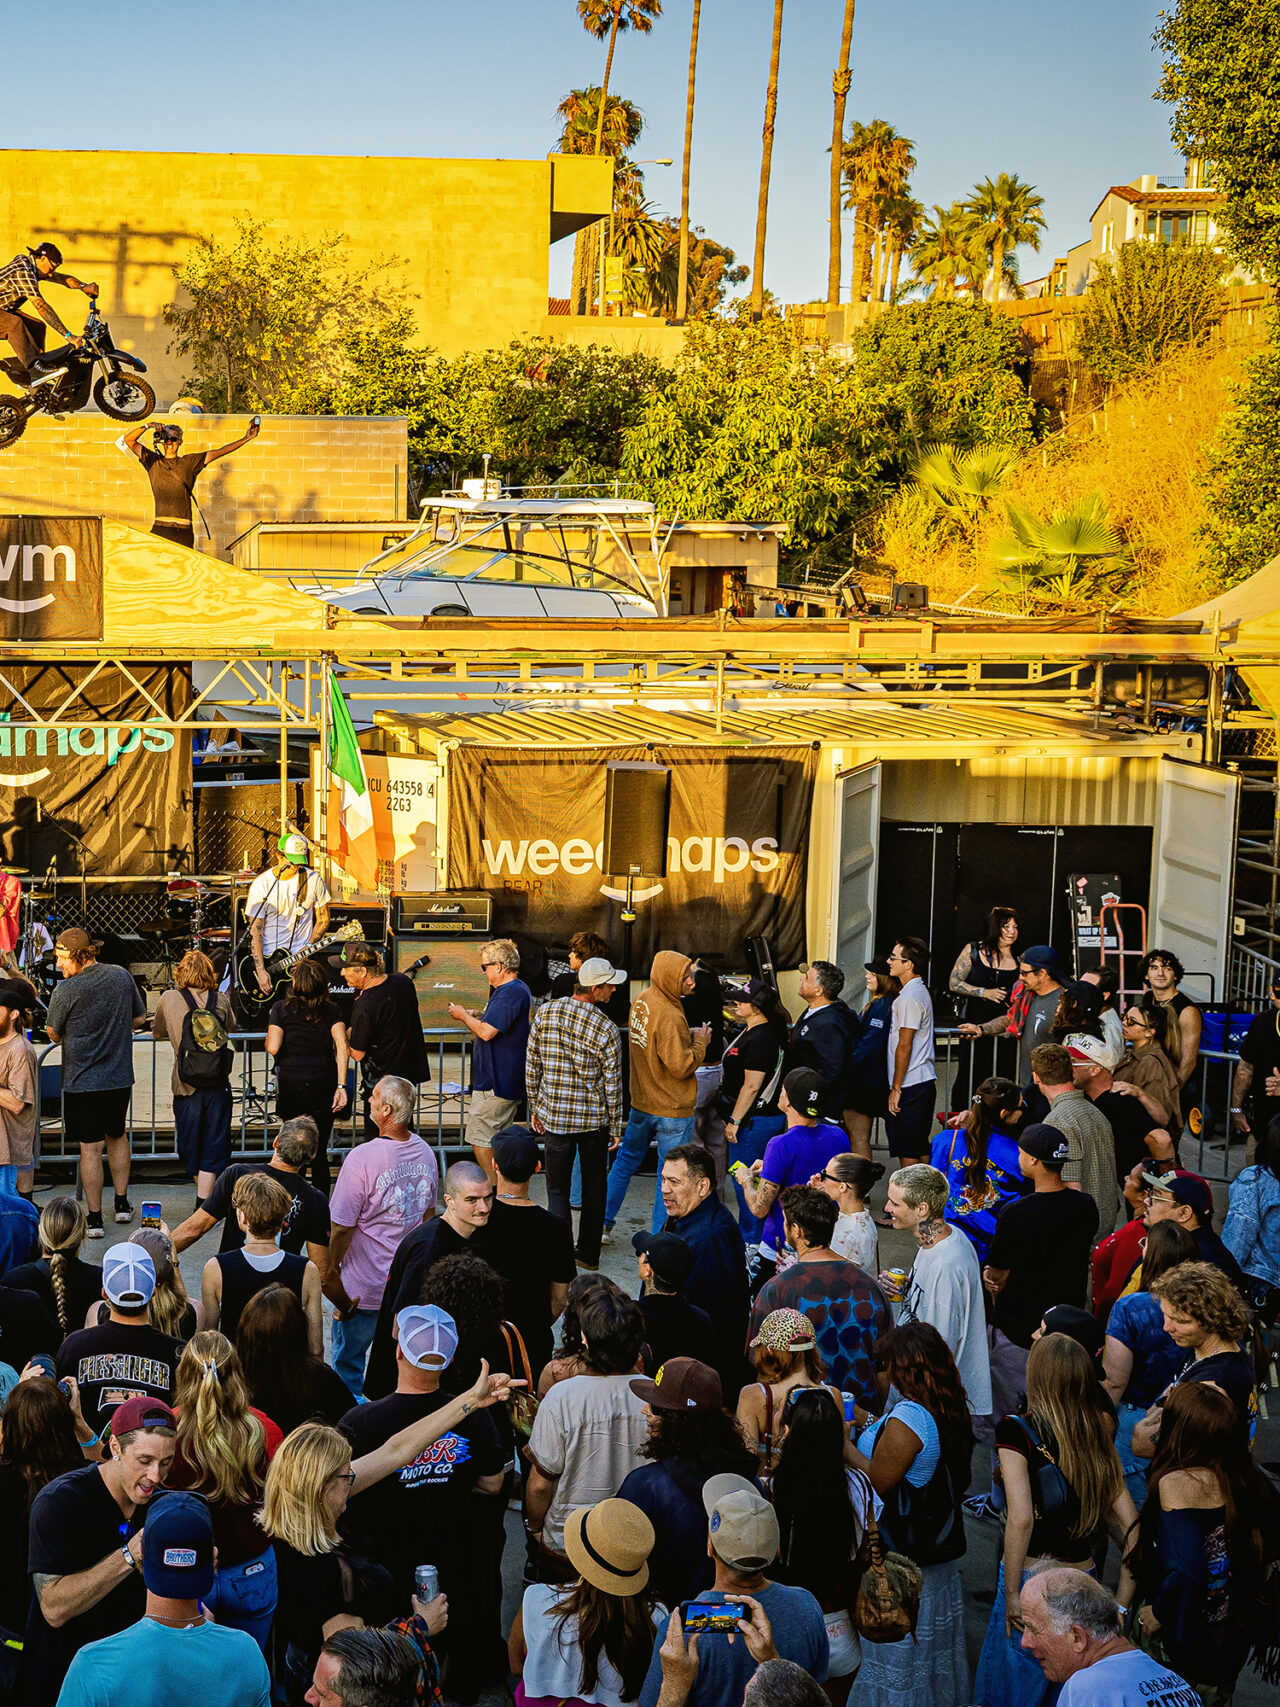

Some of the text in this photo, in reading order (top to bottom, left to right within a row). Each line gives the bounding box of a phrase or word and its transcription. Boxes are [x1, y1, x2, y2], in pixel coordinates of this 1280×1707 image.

[386, 780, 423, 797] 643558
[386, 797, 412, 812] 22G3
[482, 836, 779, 883] weeaps
[427, 903, 460, 913] Marshall
[78, 1353, 170, 1391] PLESSINGER
[400, 1463, 454, 1480] MOTO CO.
